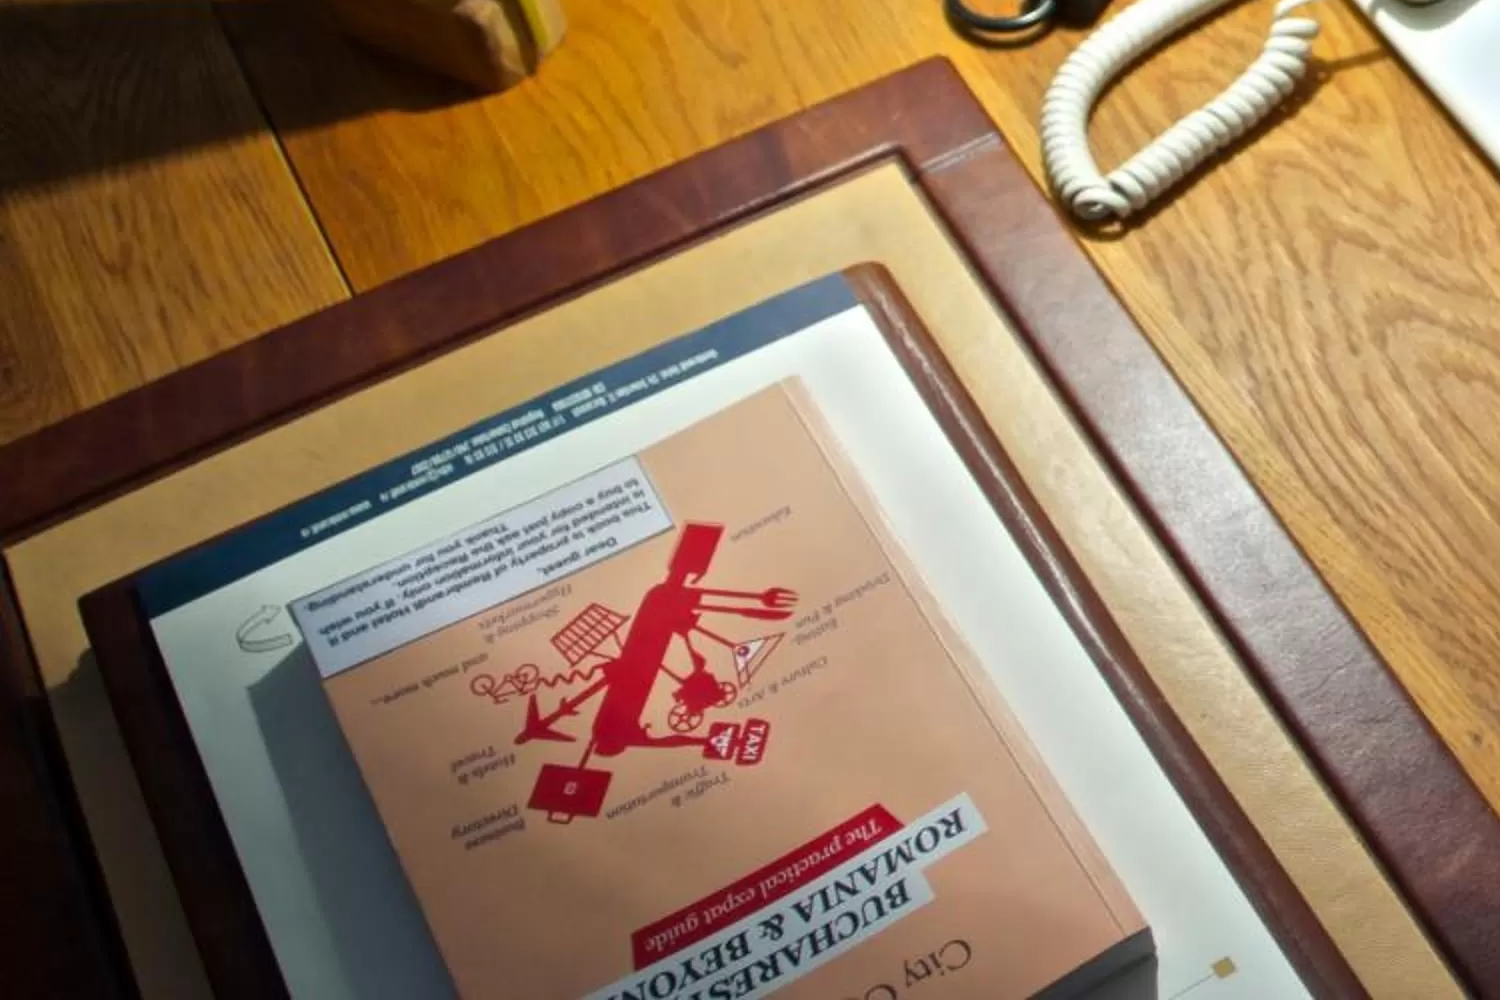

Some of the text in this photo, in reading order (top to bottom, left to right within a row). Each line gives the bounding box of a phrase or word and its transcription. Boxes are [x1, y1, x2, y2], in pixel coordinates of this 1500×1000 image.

[463, 520, 508, 548] Thank
[585, 512, 622, 536] book
[434, 538, 463, 558] you
[508, 534, 571, 570] property
[582, 534, 618, 558] Dear
[740, 722, 768, 763] TAXI
[606, 807, 967, 1000] ROMANIA & BEYON
[638, 816, 882, 958] The practical expat guide
[690, 878, 912, 1000] BUCHARES
[903, 938, 973, 989] City
